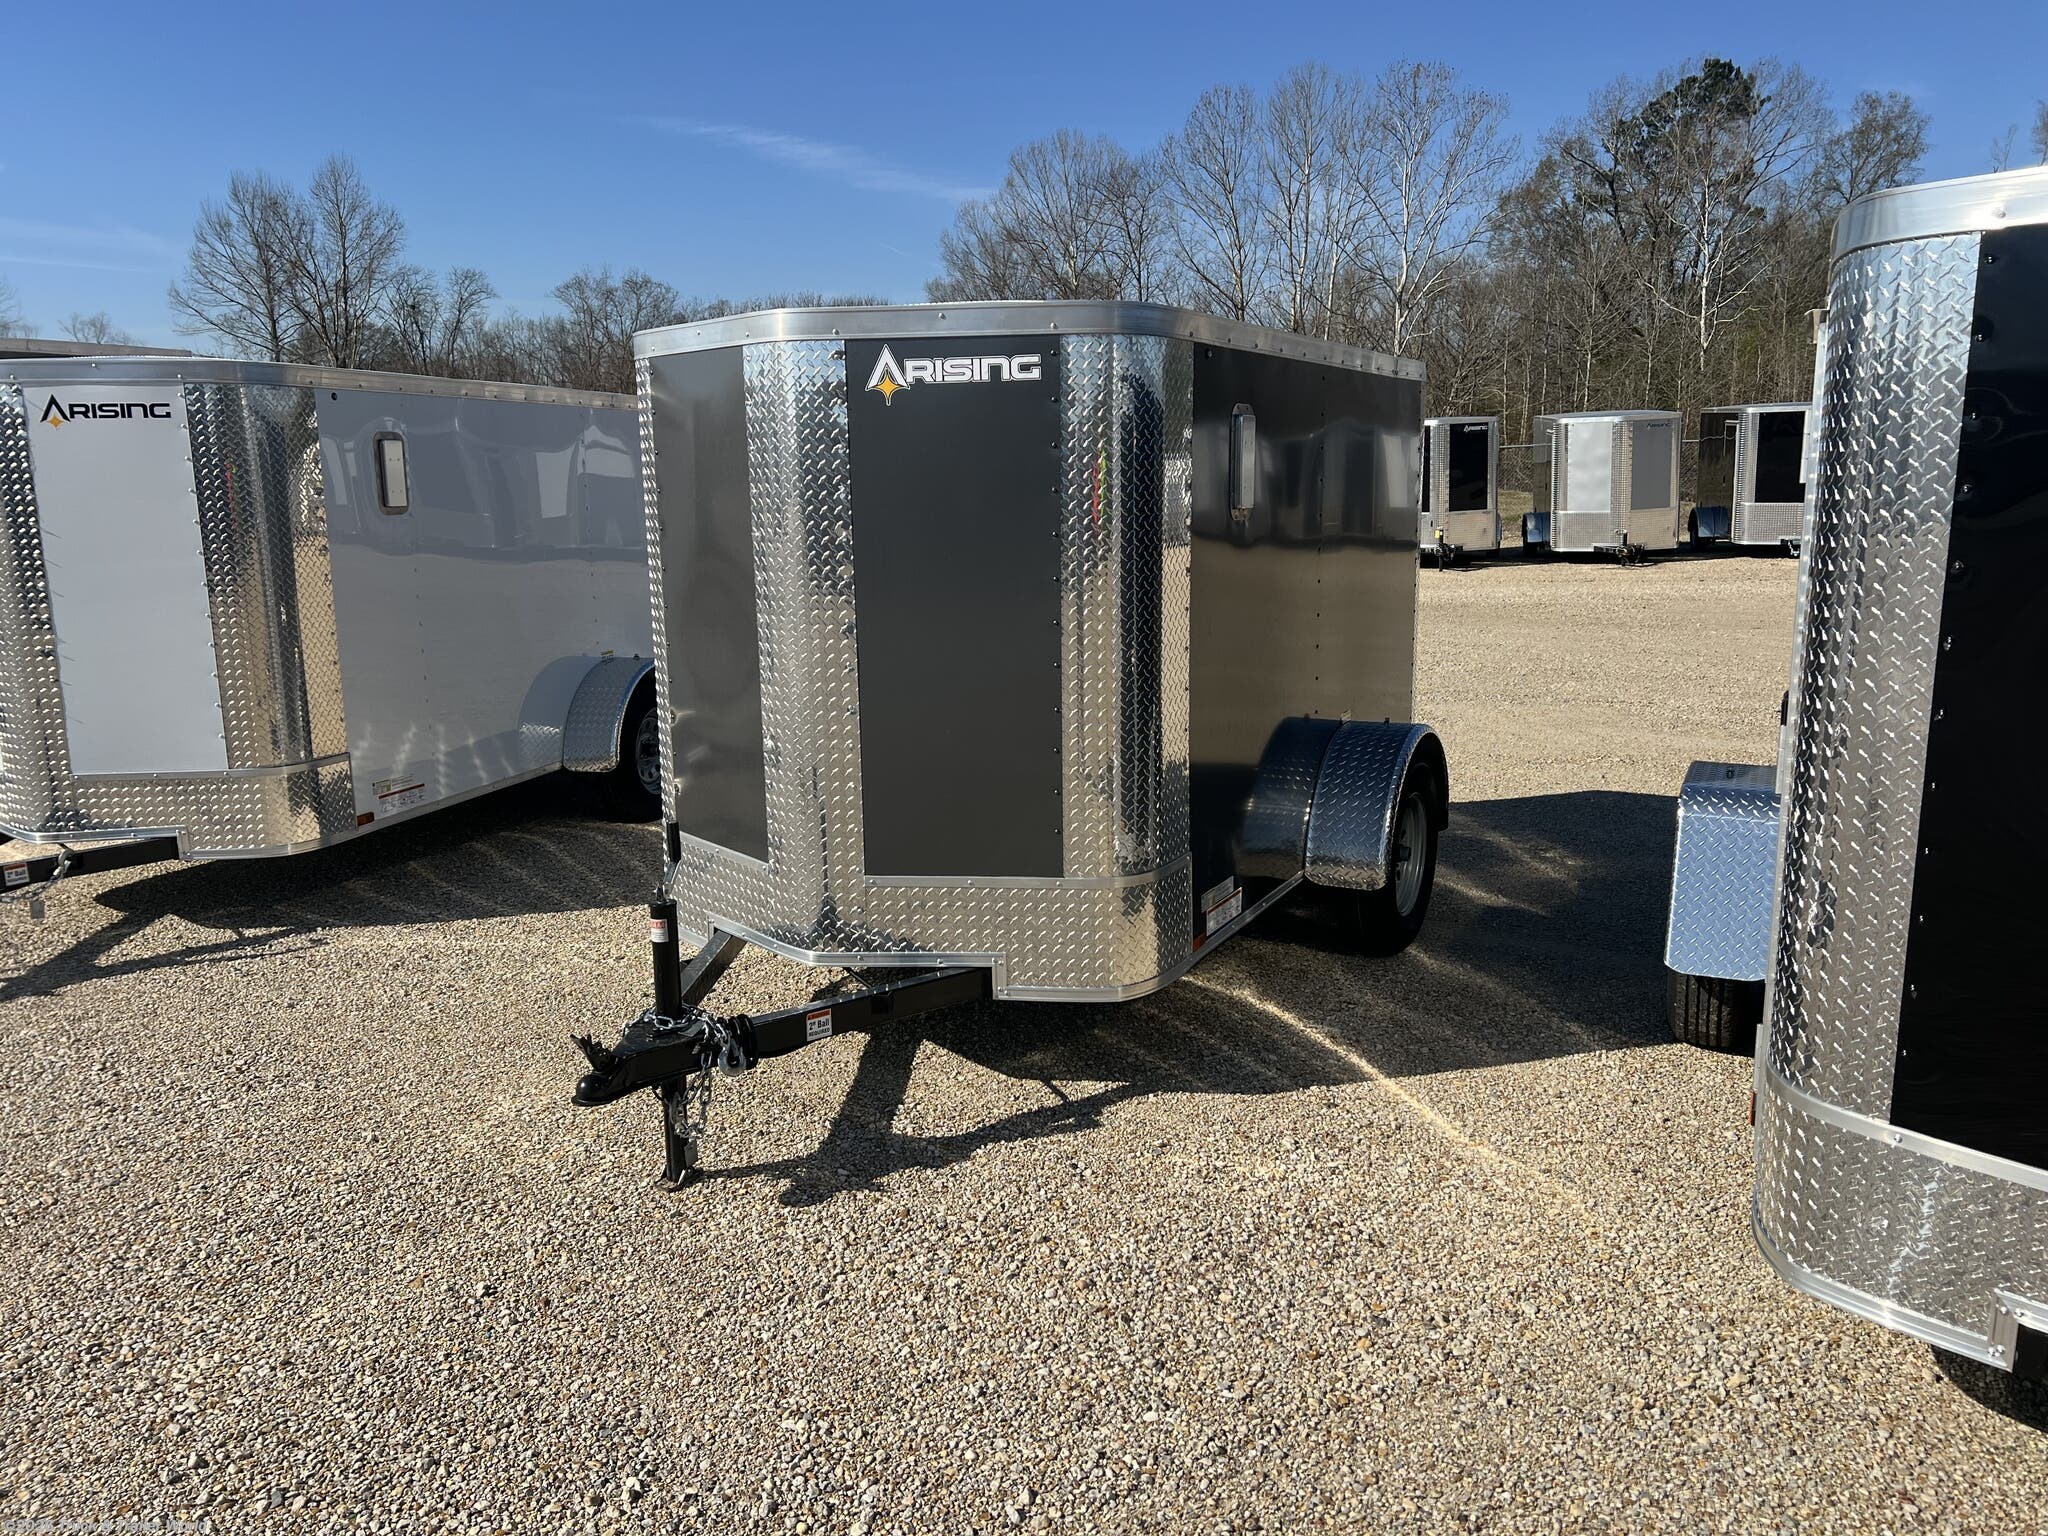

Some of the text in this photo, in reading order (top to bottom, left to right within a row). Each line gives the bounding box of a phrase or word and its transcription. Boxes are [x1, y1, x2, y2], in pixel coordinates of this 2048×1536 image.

[865, 344, 1042, 391] ARISING
[40, 394, 172, 422] ARISING
[818, 1018, 830, 1029] Ball
